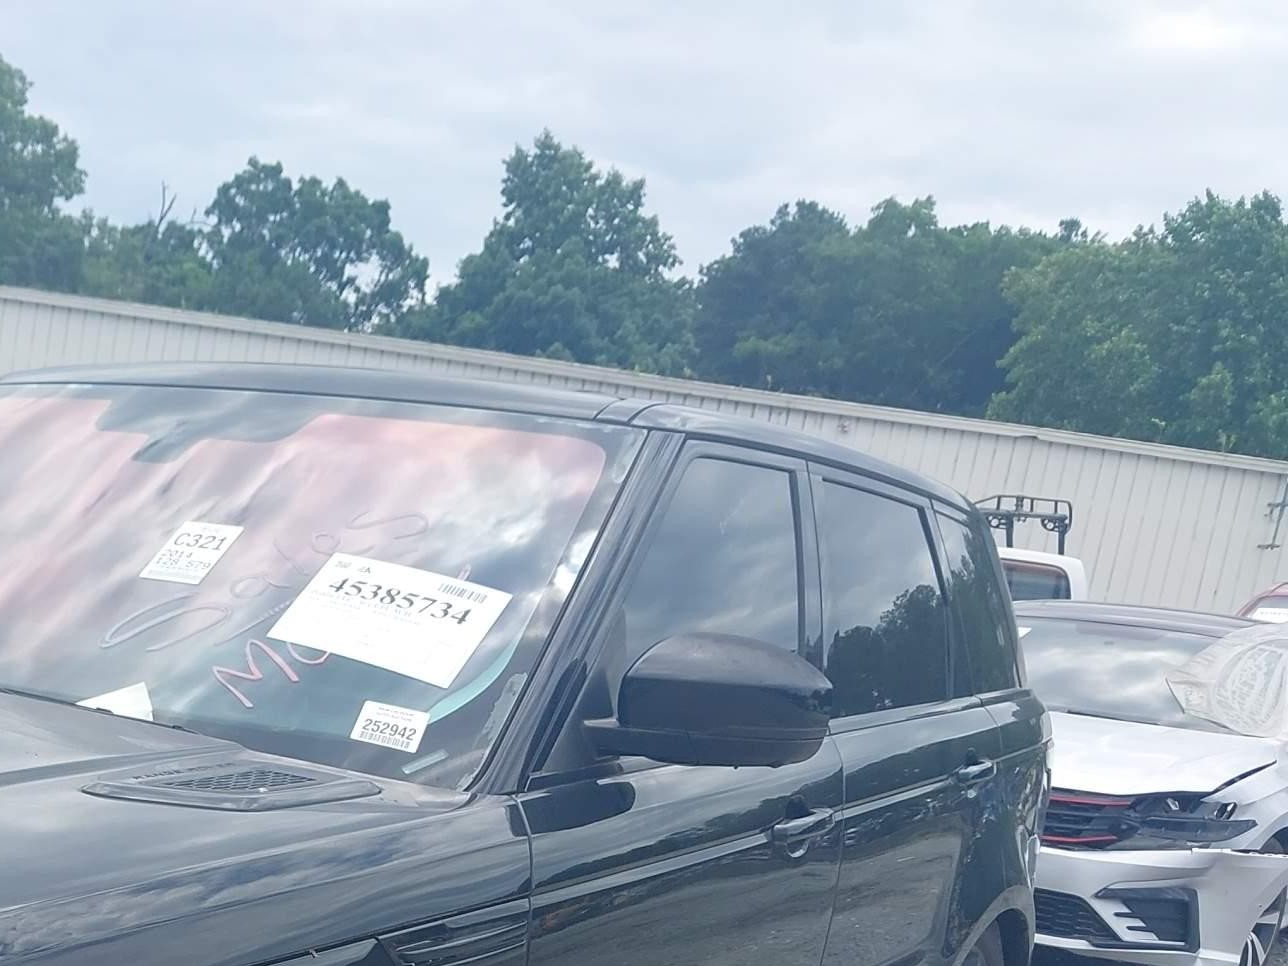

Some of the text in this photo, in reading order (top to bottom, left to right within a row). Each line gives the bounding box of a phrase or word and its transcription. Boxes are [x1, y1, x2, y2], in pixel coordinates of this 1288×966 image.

[174, 533, 228, 550] C321
[328, 577, 472, 625] 45385734
[362, 718, 417, 741] 252942
